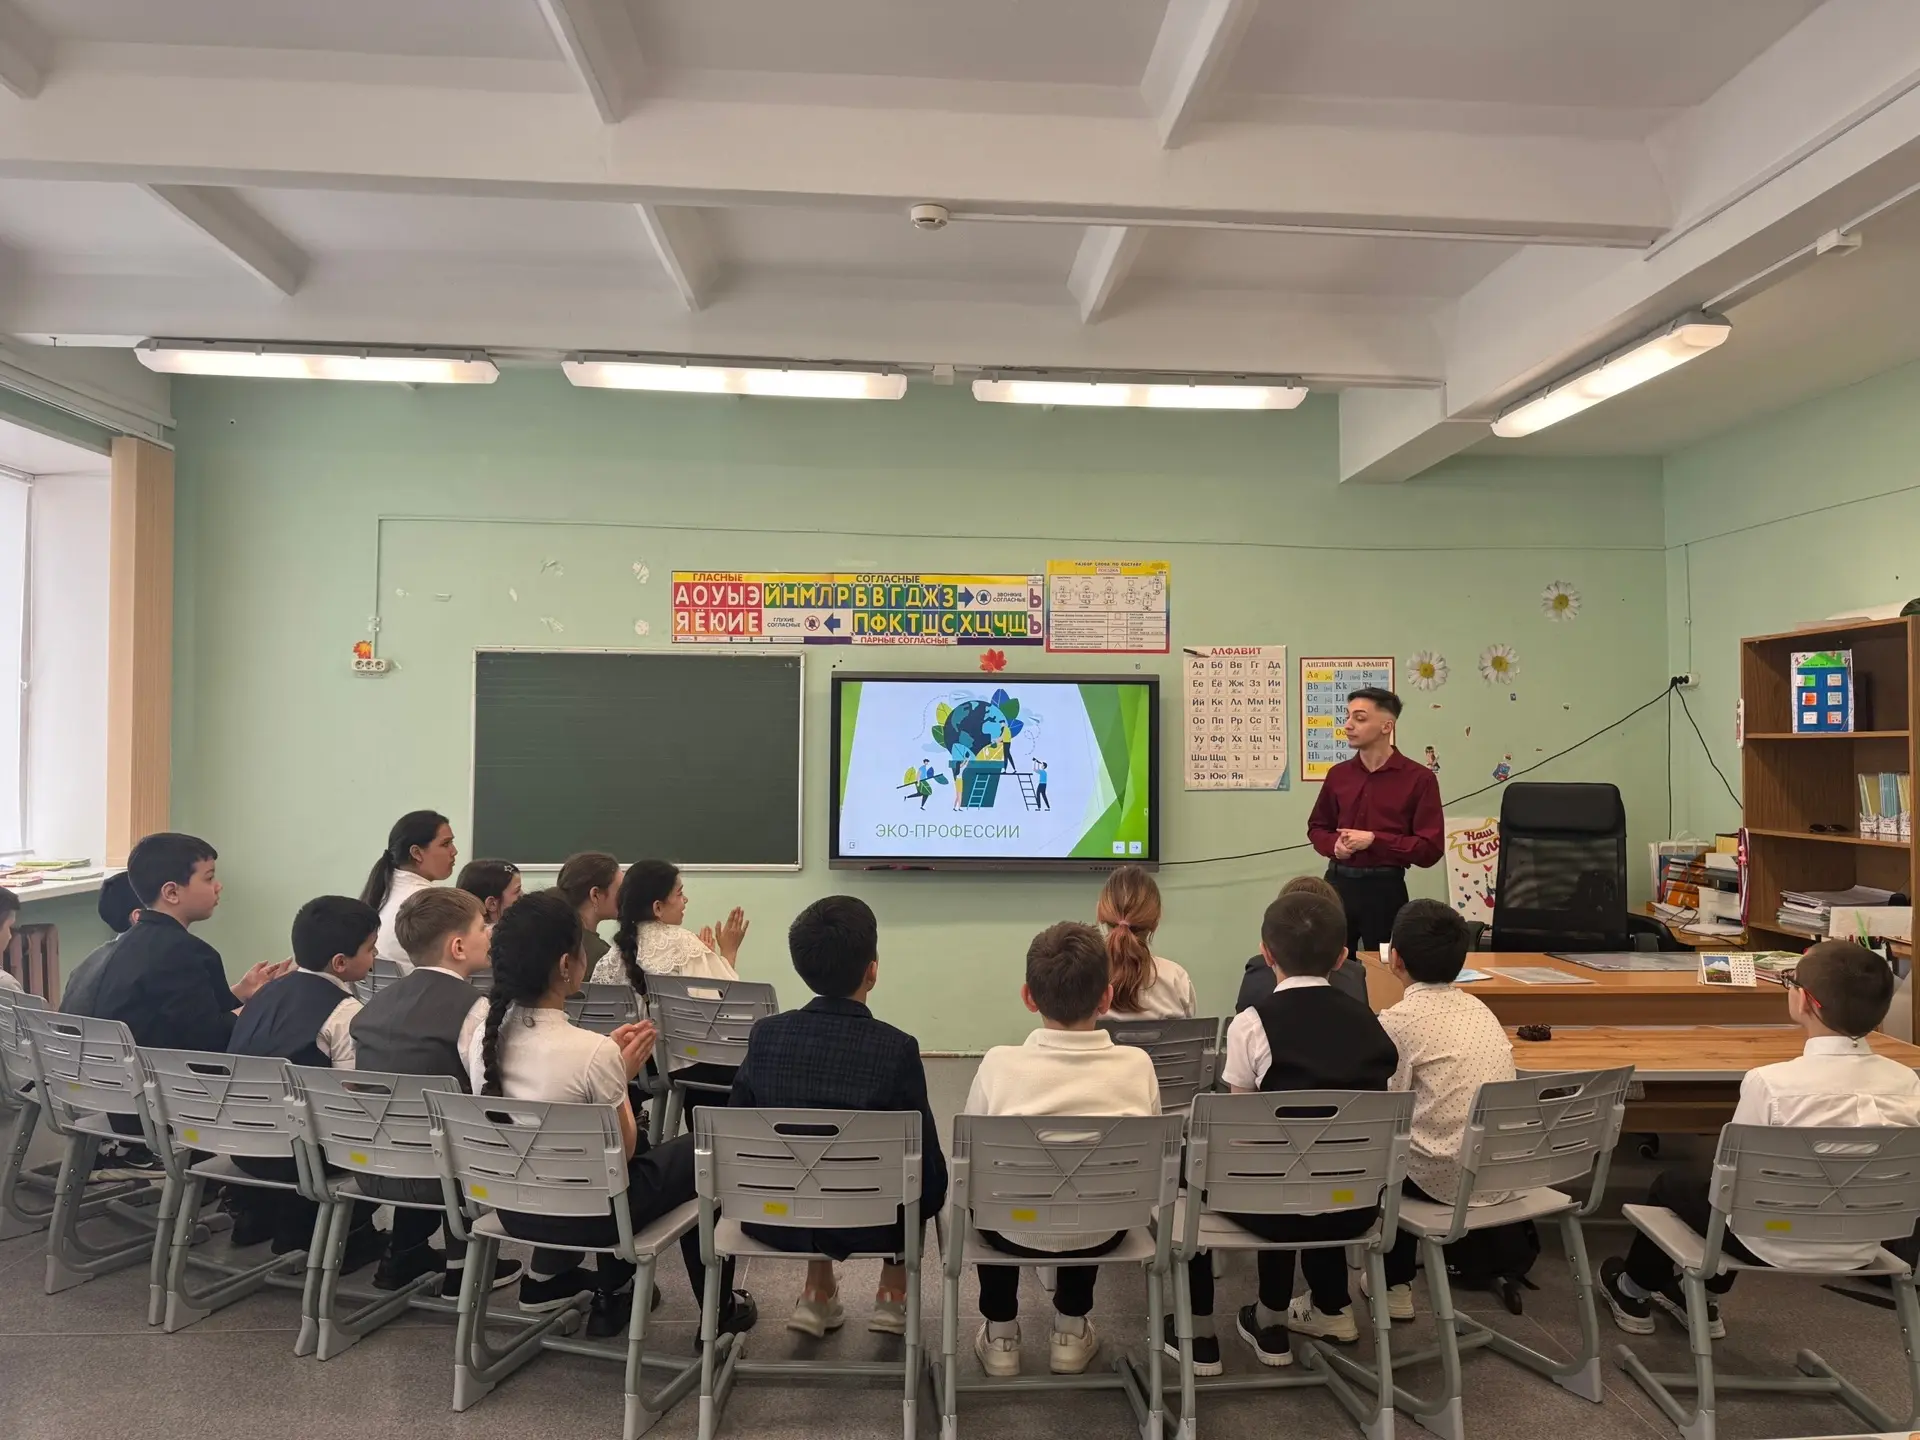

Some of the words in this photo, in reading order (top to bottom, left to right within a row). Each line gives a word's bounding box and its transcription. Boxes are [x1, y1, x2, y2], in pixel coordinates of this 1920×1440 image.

[692, 573, 743, 582] ГЛАСНЫЕ
[856, 574, 920, 584] СОГЛАСНЫЕ
[1210, 647, 1262, 655] АЛФАВИТ
[1308, 705, 1318, 713] Dd
[1308, 717, 1317, 725] Ee
[1308, 740, 1318, 748] Gg
[1336, 740, 1346, 748] Pp
[1308, 752, 1319, 760] Hh
[875, 823, 1020, 838] ЭКО-ПРОФЕССИИ
[1464, 828, 1495, 841] Наш
